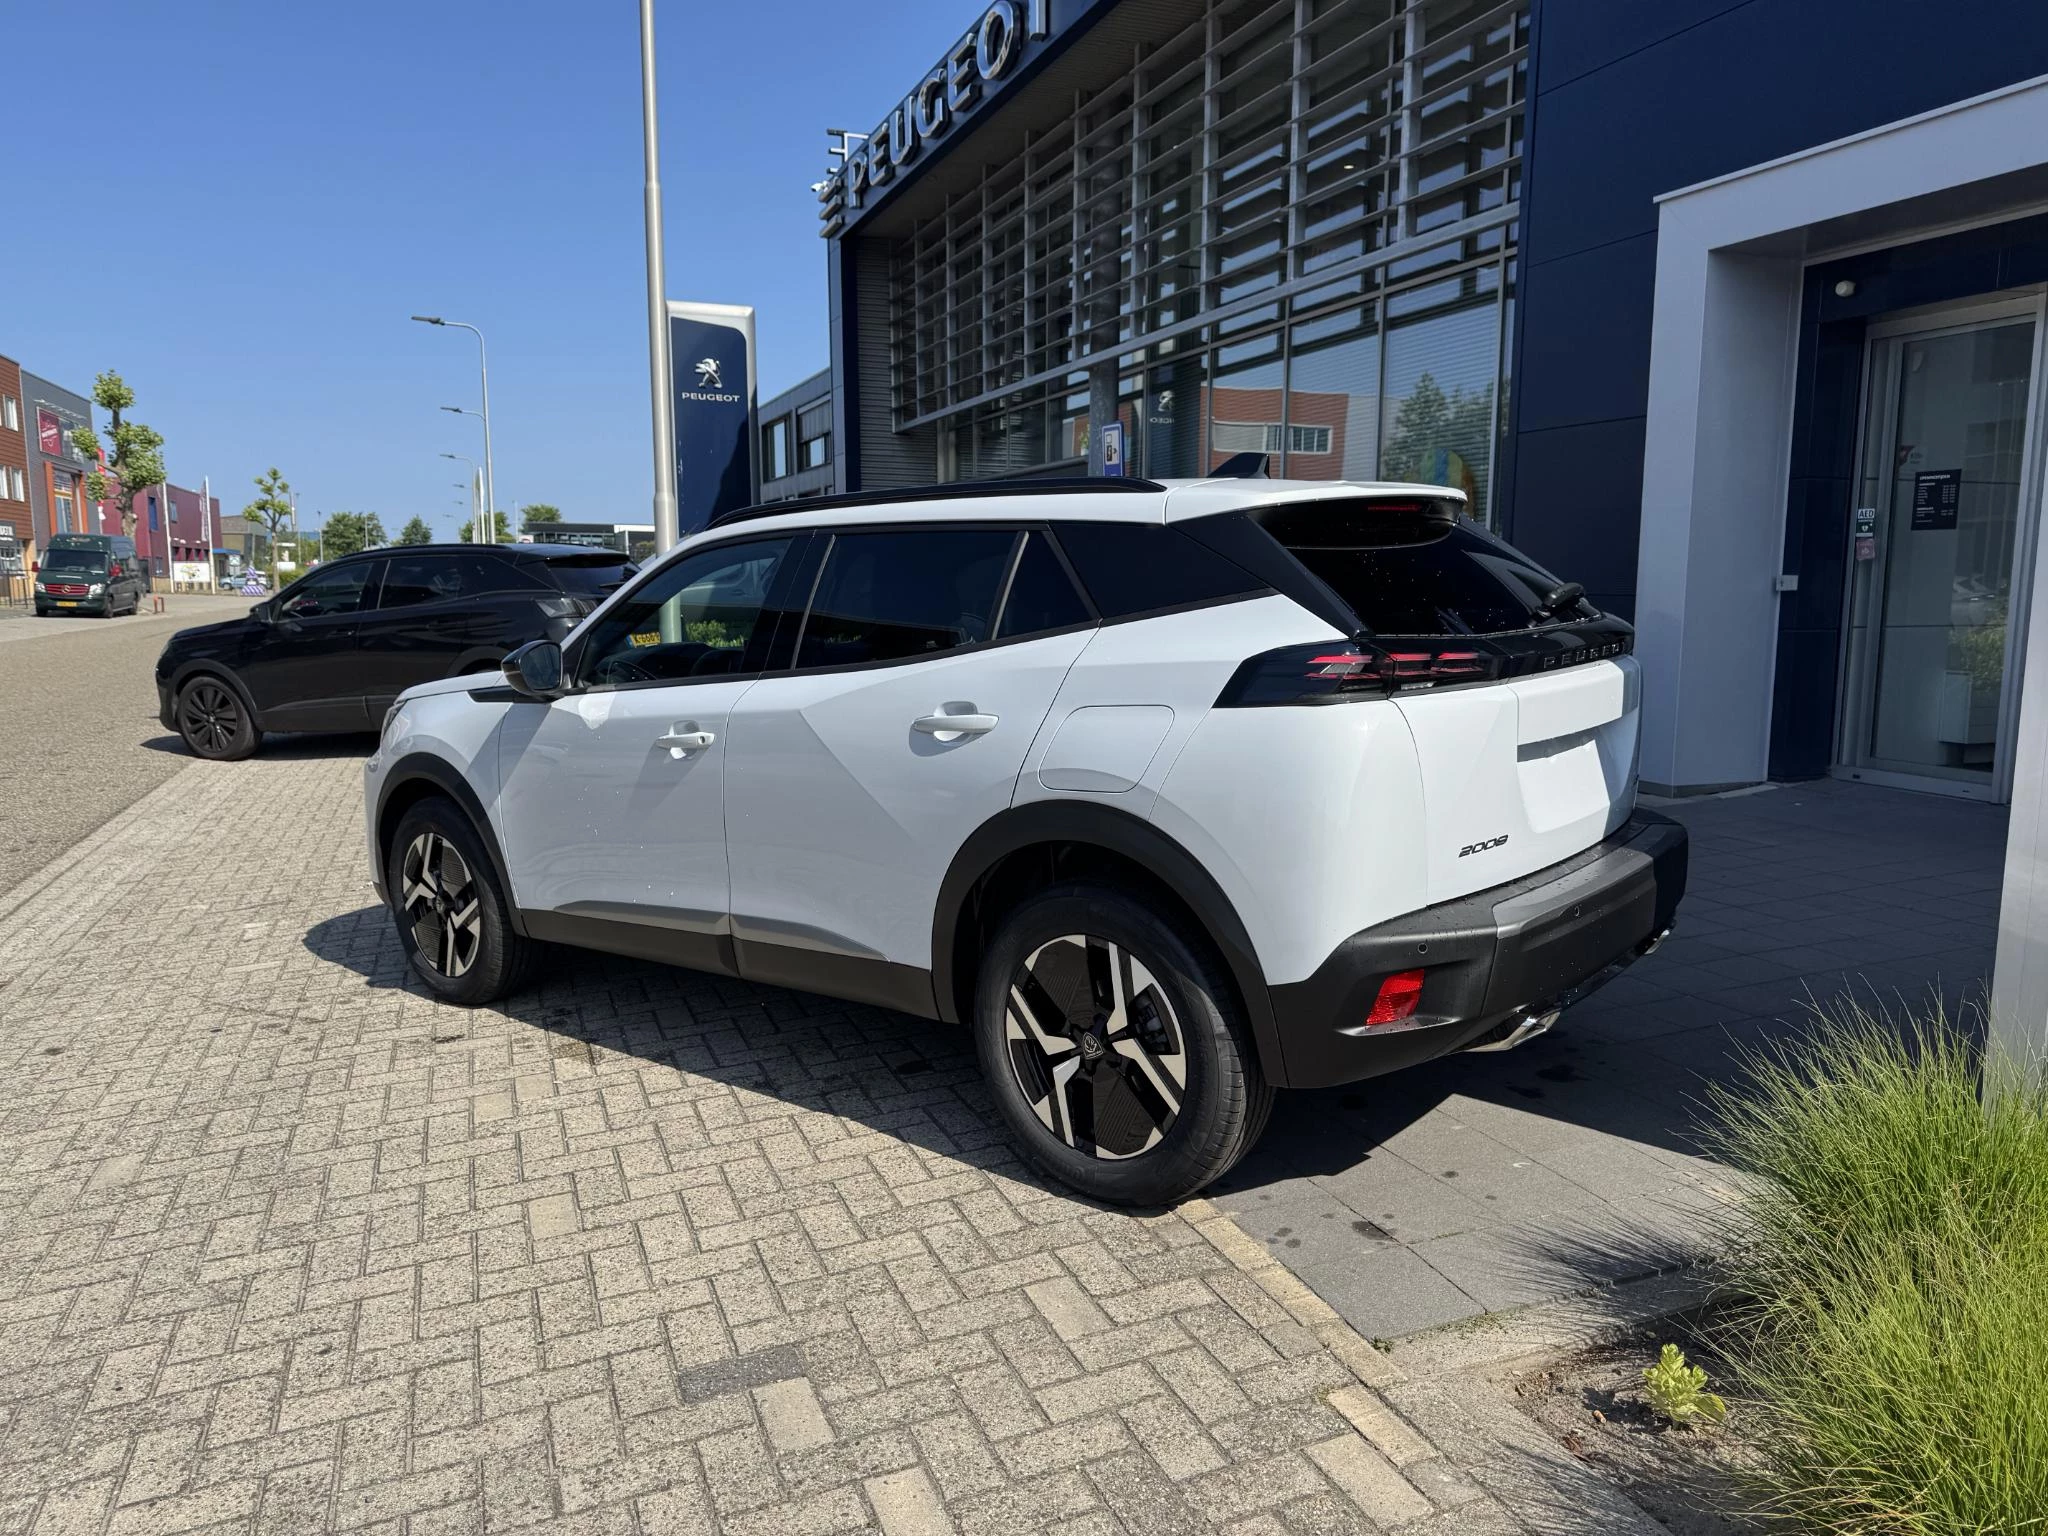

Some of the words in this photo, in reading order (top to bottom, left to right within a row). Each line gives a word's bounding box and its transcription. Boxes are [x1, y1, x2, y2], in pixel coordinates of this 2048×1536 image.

[681, 391, 740, 403] PEUGEOT
[1858, 509, 1874, 519] AED
[1458, 834, 1508, 858] 2008
